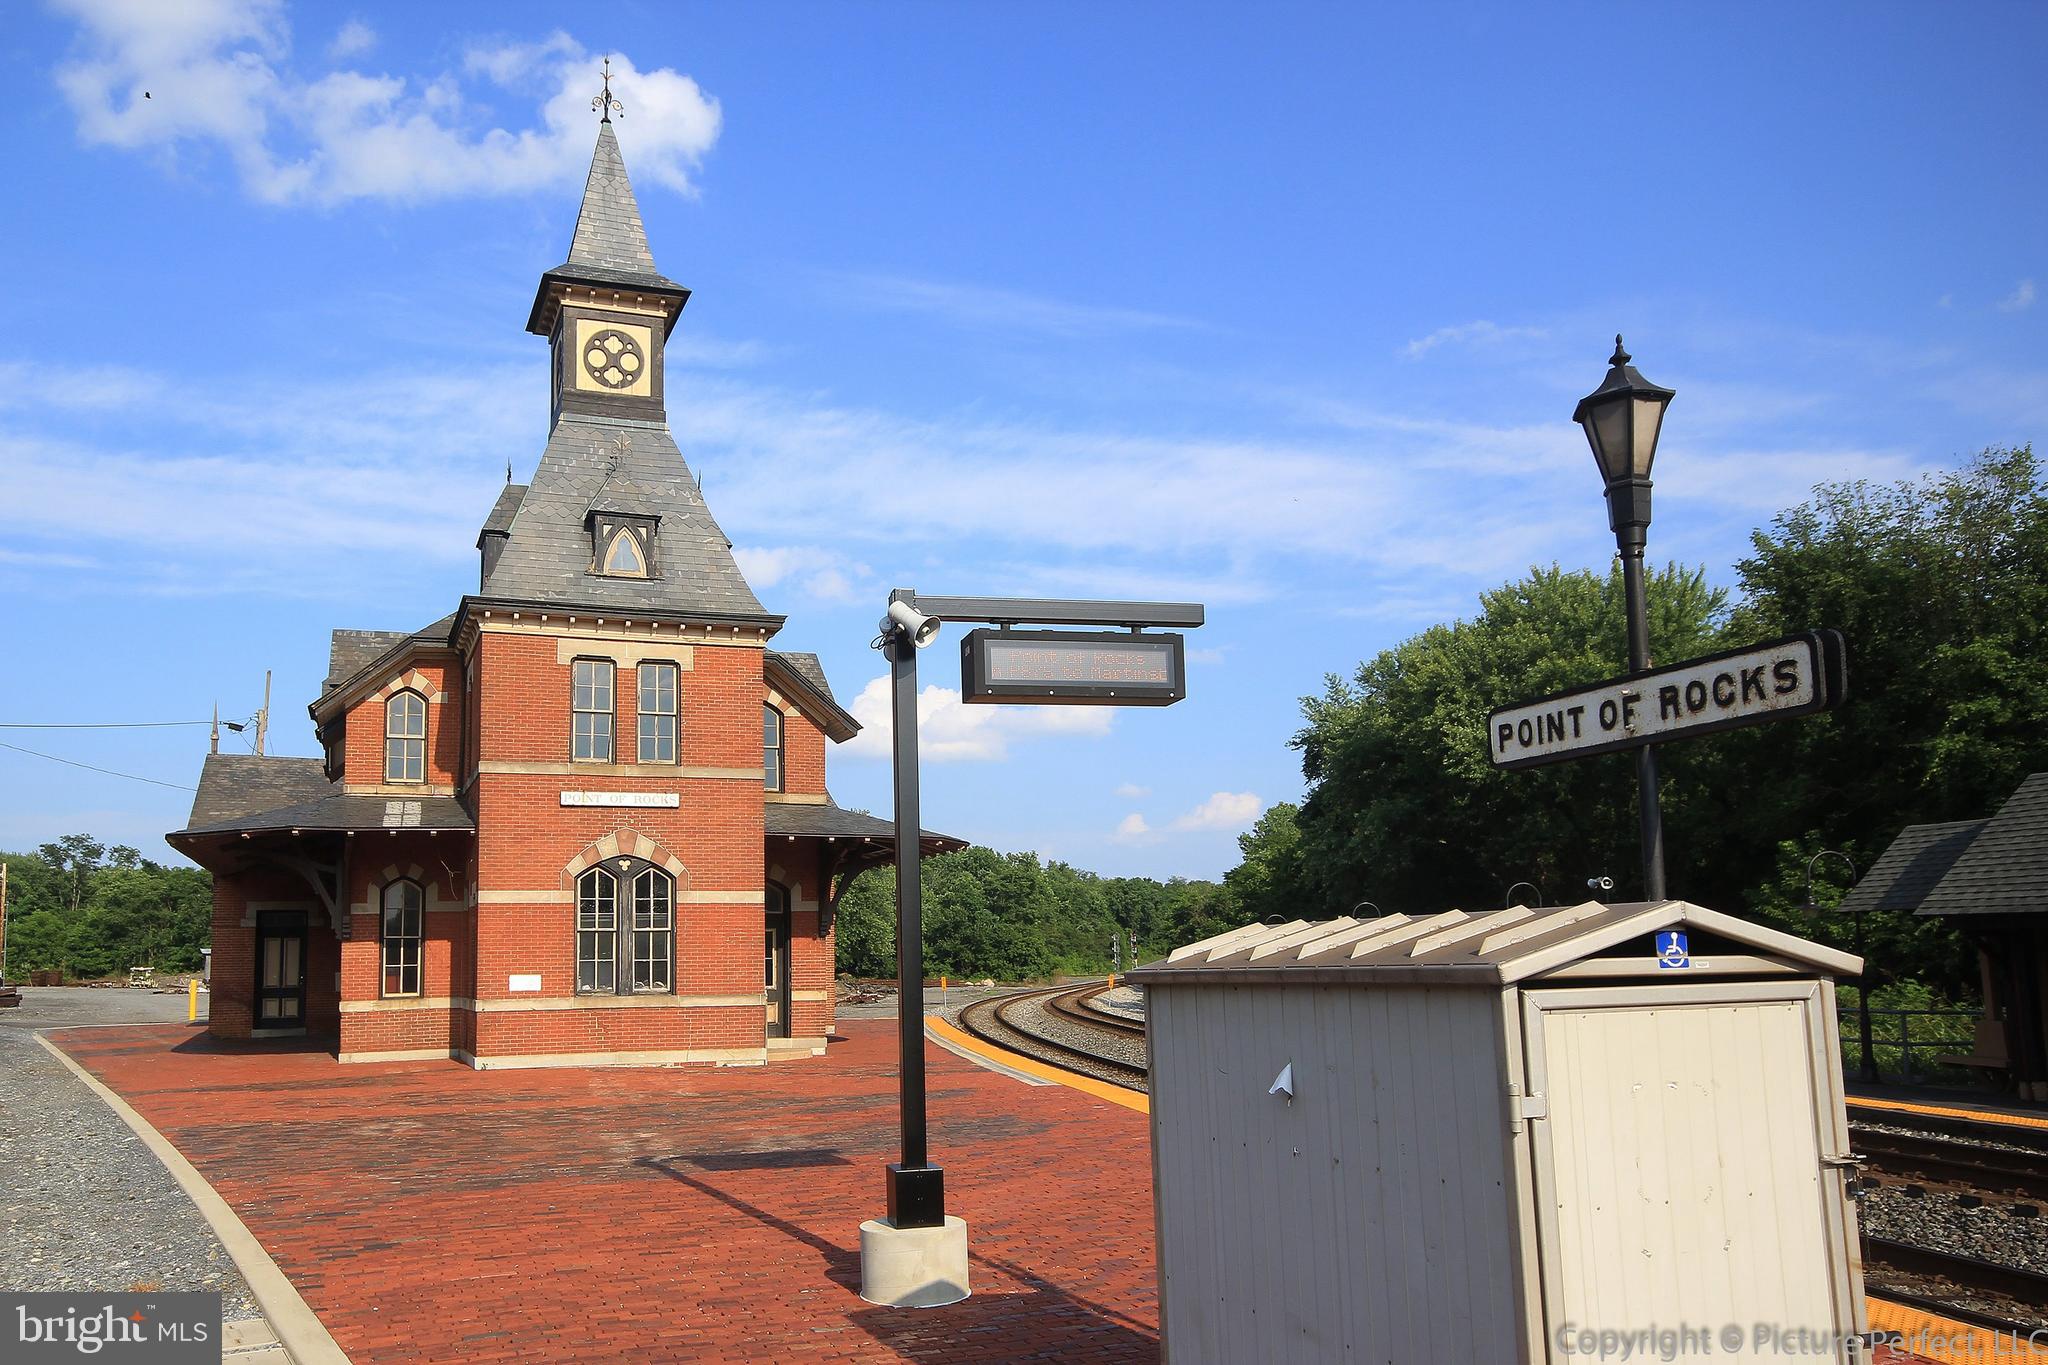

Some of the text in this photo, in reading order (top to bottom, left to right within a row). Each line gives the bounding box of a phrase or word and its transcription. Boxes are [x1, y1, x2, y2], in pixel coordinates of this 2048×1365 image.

[1498, 658, 1799, 753] POINT OF ROCKS
[563, 793, 678, 805] POINT OF ROCKS
